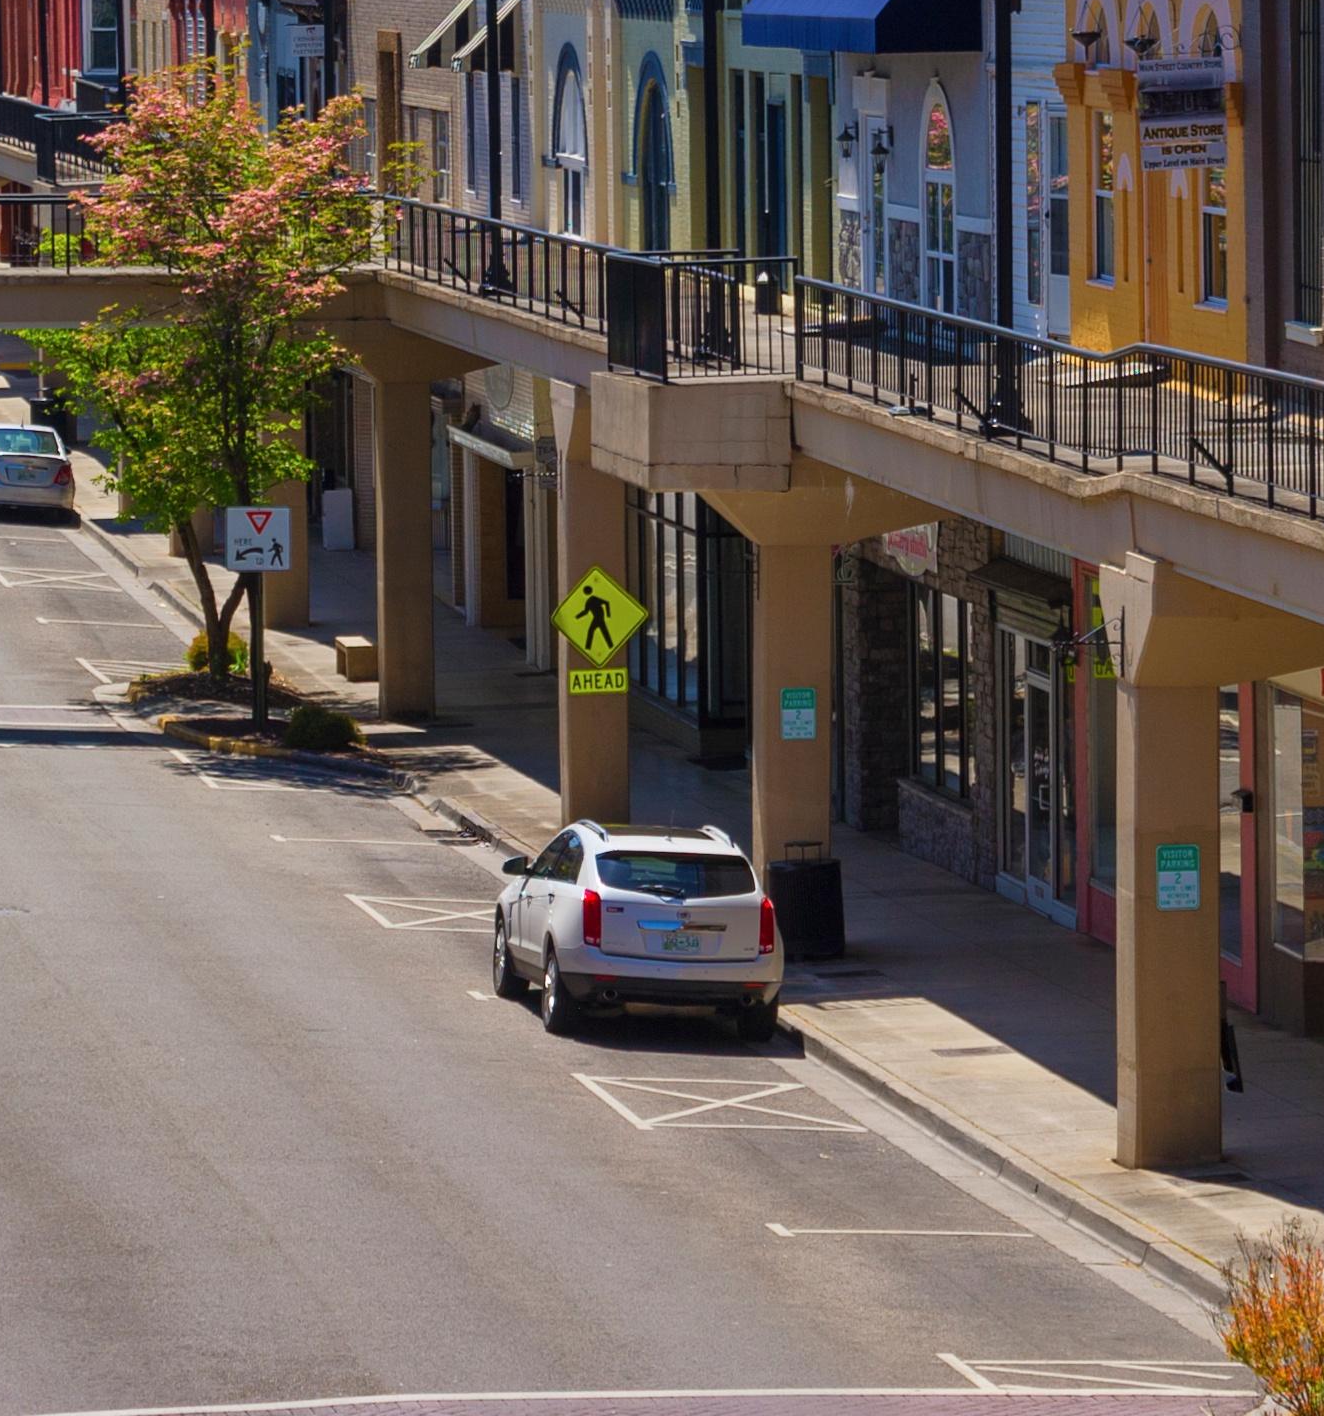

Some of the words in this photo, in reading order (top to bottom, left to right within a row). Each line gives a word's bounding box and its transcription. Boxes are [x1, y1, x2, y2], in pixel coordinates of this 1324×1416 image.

[1143, 127, 1188, 139] ANTIQUE
[1191, 125, 1224, 136] STORE
[572, 672, 625, 690] AHEAD
[795, 710, 802, 720] 2
[1162, 849, 1194, 859] VISITOR
[1160, 860, 1196, 870] PARKING
[1174, 873, 1182, 884] 2
